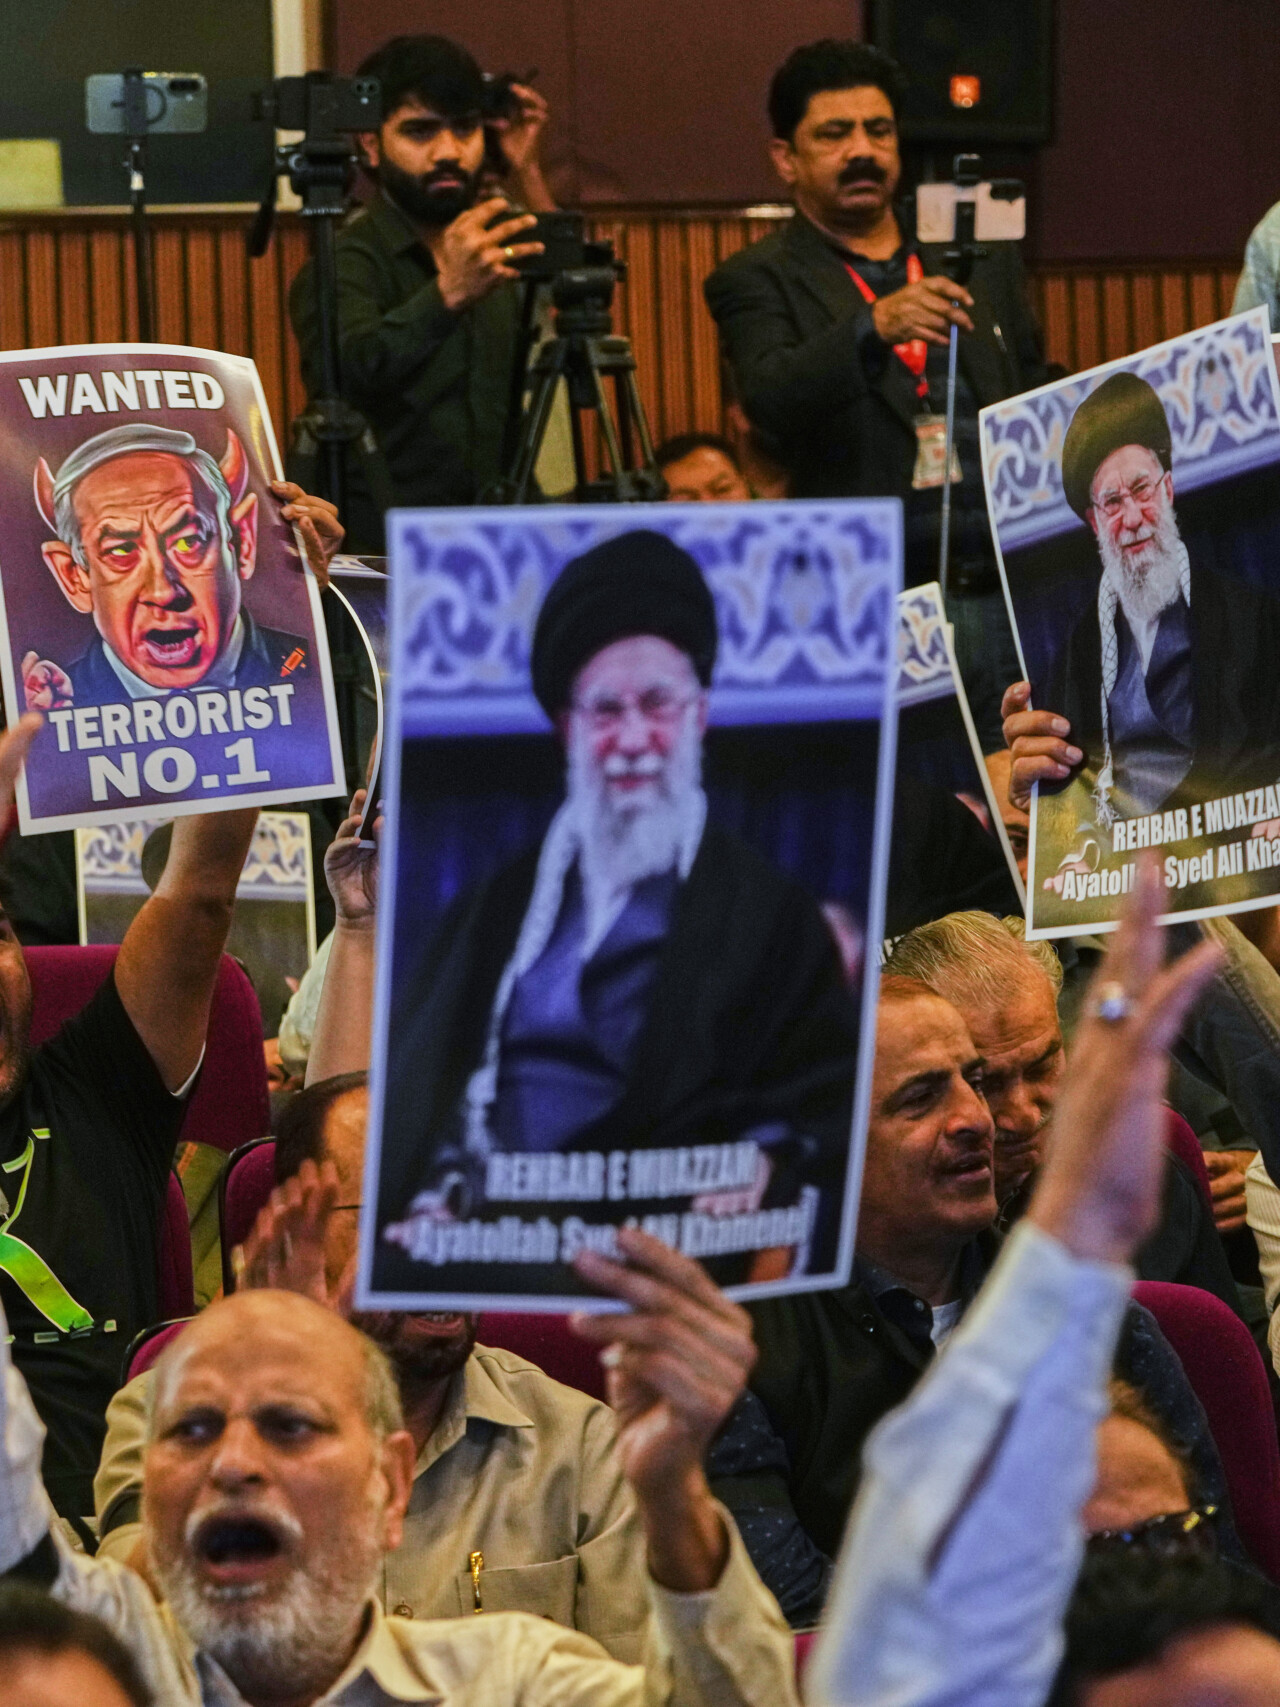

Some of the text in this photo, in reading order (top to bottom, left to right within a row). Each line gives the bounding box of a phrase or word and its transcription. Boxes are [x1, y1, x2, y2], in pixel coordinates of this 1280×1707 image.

[19, 370, 224, 419] WANTED
[48, 684, 295, 753] TERRORIST
[87, 737, 271, 802] NO.1
[1113, 782, 1280, 852] REHBAR E MUAZZA
[1061, 862, 1160, 902] Ayatoll
[1164, 848, 1214, 889] Syed
[1217, 841, 1244, 878] Ali
[486, 1140, 759, 1200] REHBAR E MUAZZAM
